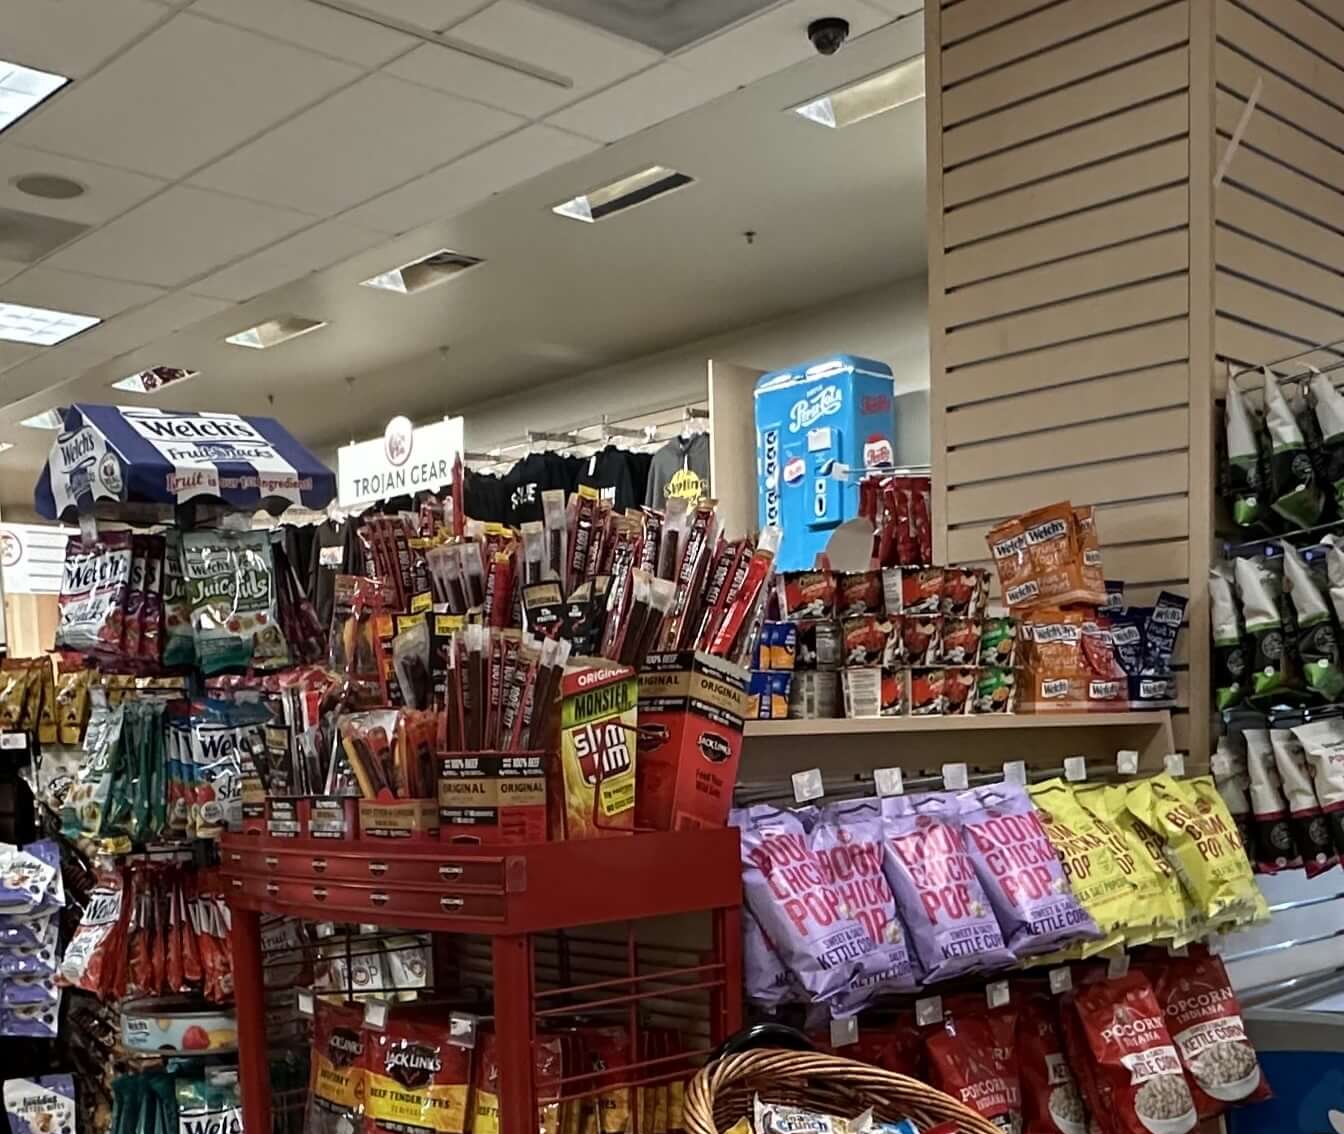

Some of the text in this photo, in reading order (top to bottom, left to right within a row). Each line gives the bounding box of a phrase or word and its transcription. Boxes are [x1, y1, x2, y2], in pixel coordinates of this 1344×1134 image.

[139, 418, 255, 438] Welch's
[60, 431, 95, 466] Welch's
[168, 445, 274, 461] Fruit Snacks
[166, 473, 204, 492] Fruit
[352, 459, 448, 497] TROJAN GEAR
[1029, 521, 1066, 541] Welch's
[996, 536, 1026, 557] Welch'
[67, 556, 129, 588] Welch's
[1007, 583, 1038, 602] Welch's
[638, 675, 680, 686] RIGINAL
[701, 679, 742, 703] ORIGINAL
[575, 683, 629, 721] MONSTER
[442, 783, 486, 794] ORIGINAL
[500, 782, 544, 794] ORIGINAL
[967, 810, 1042, 854] BOOM
[1061, 854, 1092, 885] POP
[999, 864, 1054, 909] POP
[784, 887, 841, 937] POP
[920, 883, 973, 926] POP
[1024, 913, 1068, 937] KETTLE
[816, 941, 859, 970] KETTLE
[941, 939, 985, 960] KETTLE
[1176, 1004, 1226, 1025] INDIANA
[1181, 1031, 1215, 1053] KETTLE
[384, 1052, 442, 1072] JACK LINK'S
[370, 1087, 387, 1099] BEEF
[389, 1091, 422, 1106] TENDER
[775, 1117, 830, 1133] Crunch
